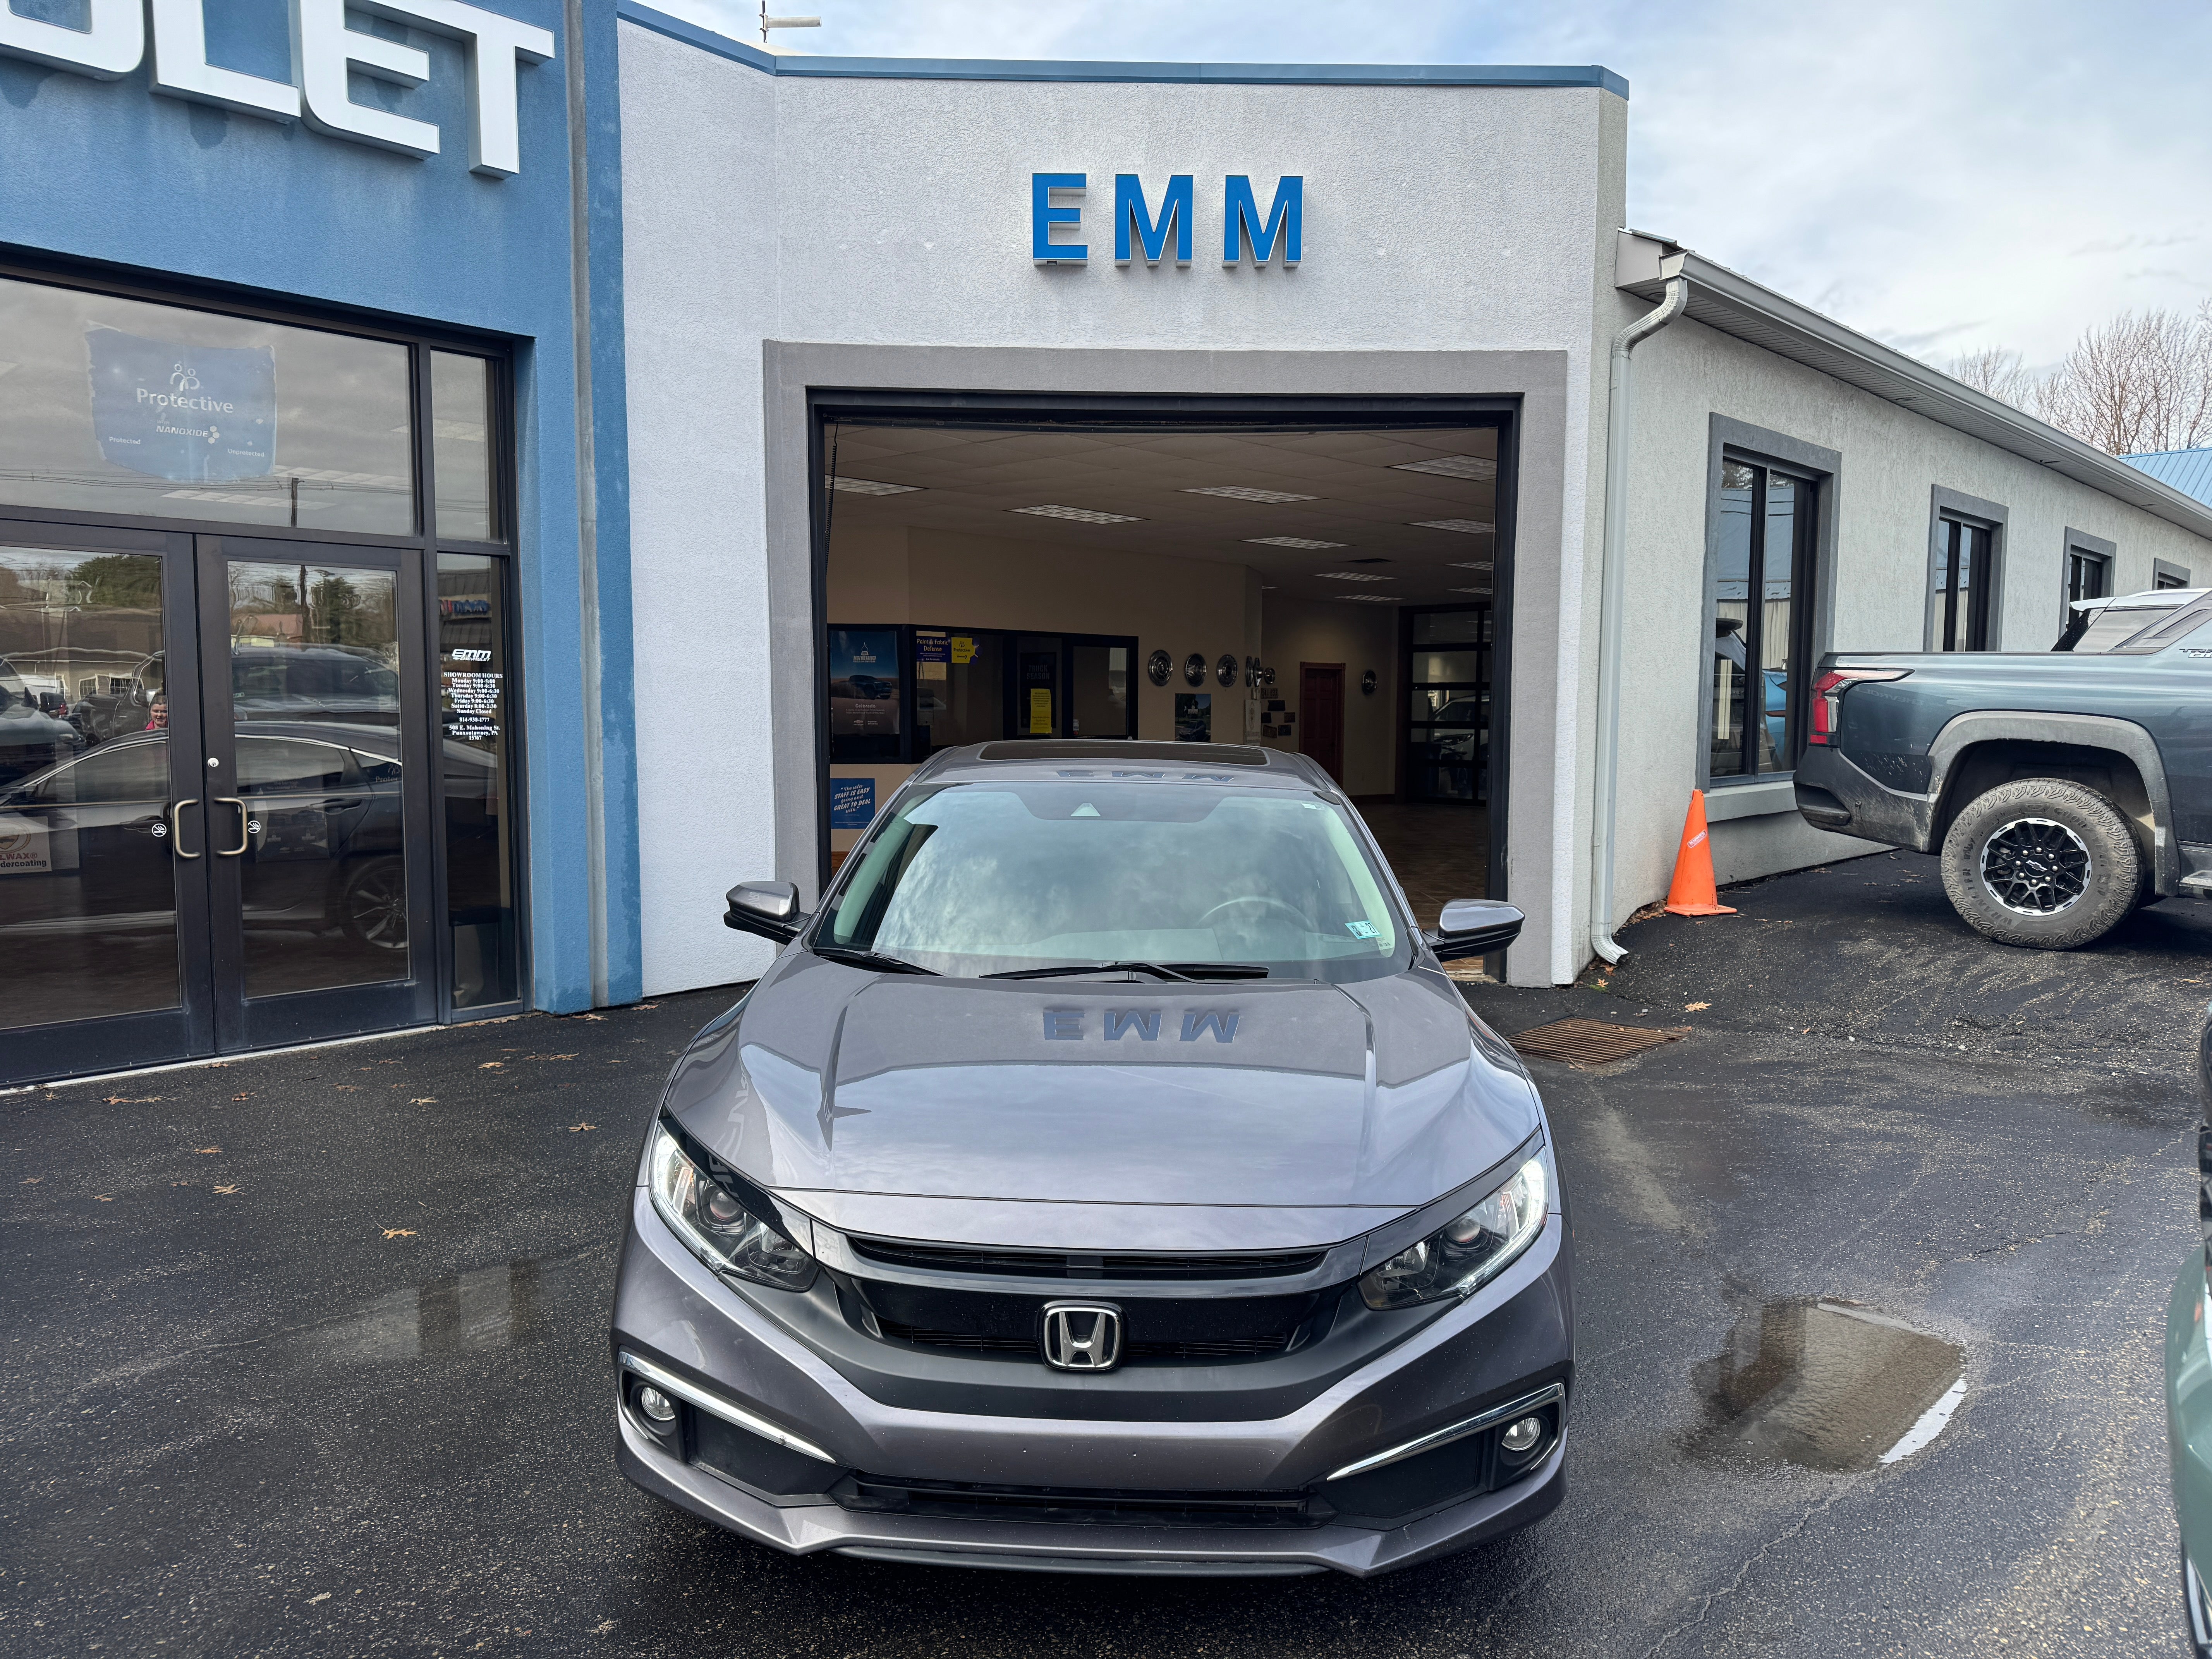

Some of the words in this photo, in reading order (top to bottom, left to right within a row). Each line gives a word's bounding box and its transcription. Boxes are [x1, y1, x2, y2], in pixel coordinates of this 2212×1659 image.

[1032, 172, 1304, 267] EMM
[136, 387, 234, 413] Protective
[156, 426, 209, 437] NANOXIDE
[109, 436, 141, 445] Protected
[228, 448, 264, 457] Unprotected
[834, 791, 850, 799] STAFF
[857, 787, 871, 795] EASY
[834, 802, 850, 811] GREAT
